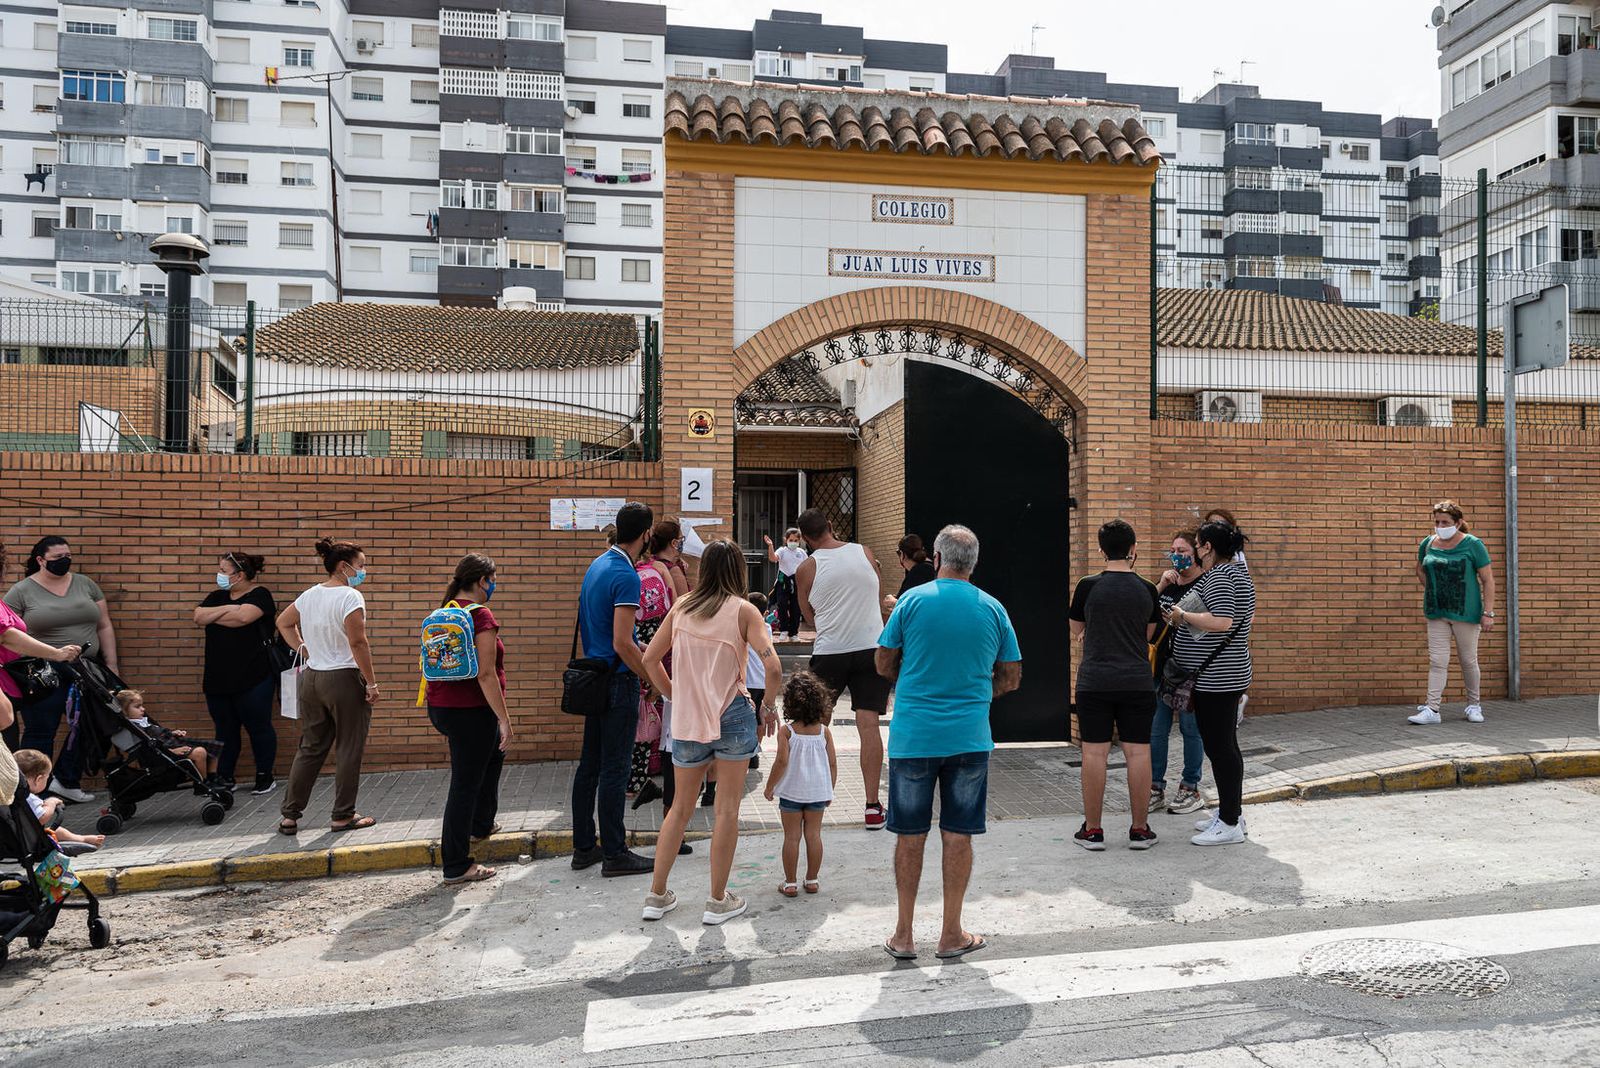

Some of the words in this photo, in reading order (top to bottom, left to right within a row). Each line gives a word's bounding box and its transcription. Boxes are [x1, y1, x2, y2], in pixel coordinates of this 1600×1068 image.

[879, 200, 946, 219] COLEGIO
[843, 255, 883, 272] JUAN
[891, 257, 928, 274] LUIS
[935, 259, 982, 276] VIVES
[688, 480, 701, 501] 2
